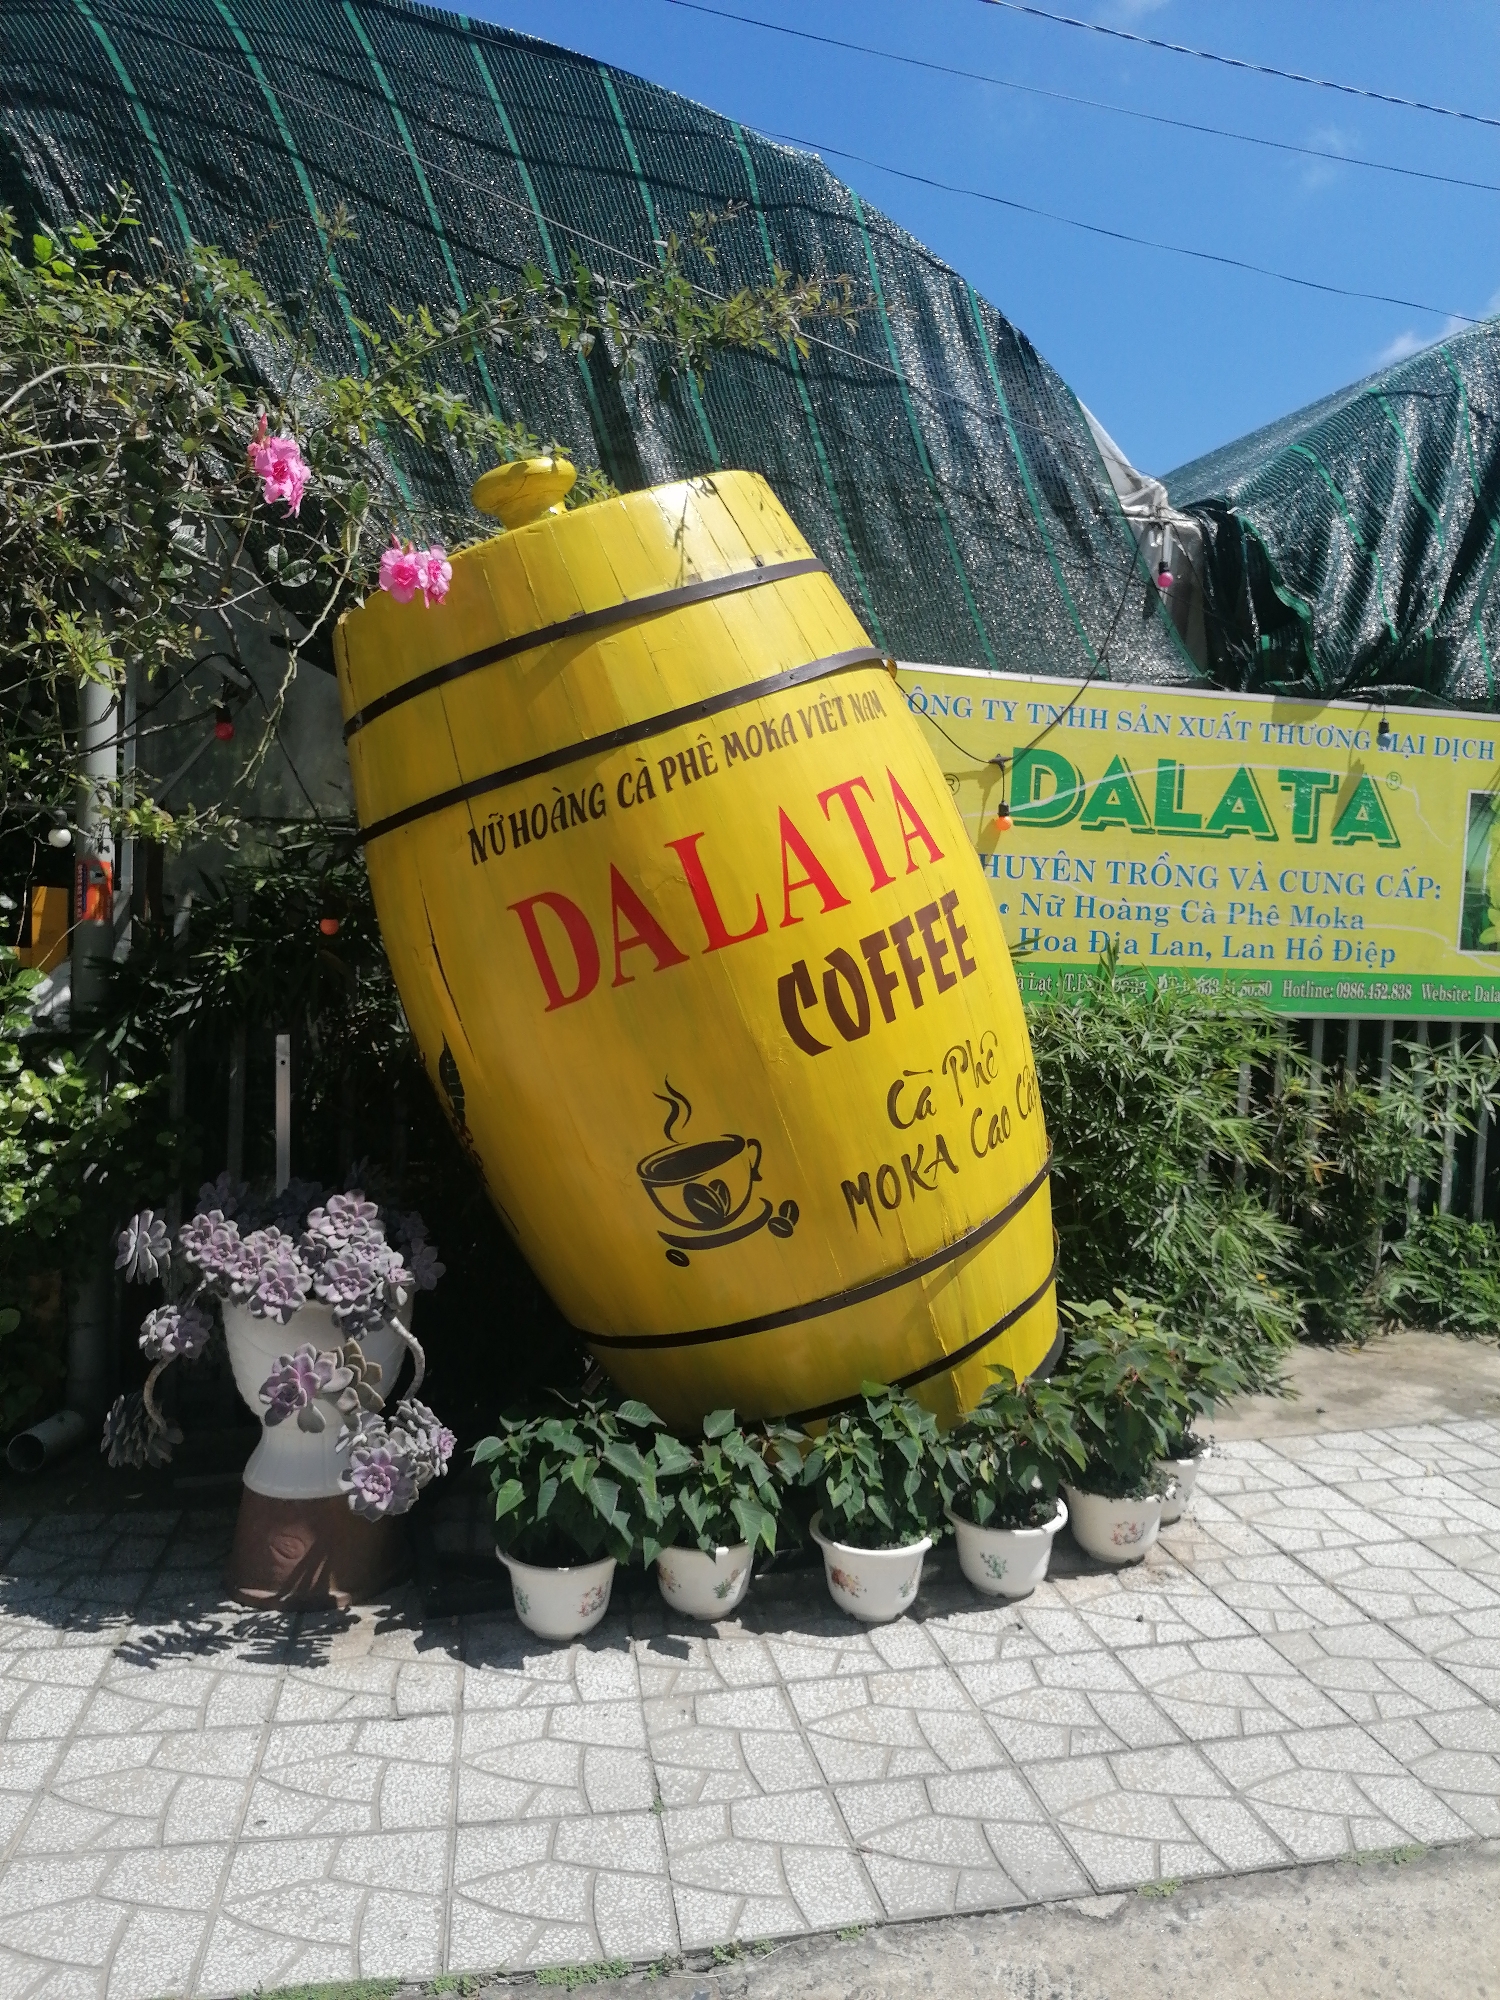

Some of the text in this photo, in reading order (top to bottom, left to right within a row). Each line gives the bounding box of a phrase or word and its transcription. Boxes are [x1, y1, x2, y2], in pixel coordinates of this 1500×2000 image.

[508, 783, 606, 849] HOÀNG
[617, 757, 657, 809] CÀ
[657, 736, 718, 793] PHÊ
[720, 711, 799, 768] MOKA
[847, 690, 887, 724] NAM
[904, 687, 972, 718] ÔNG
[982, 699, 1019, 722] TY
[1027, 703, 1108, 730] TNHH
[1117, 704, 1171, 735] SẢN
[1179, 711, 1252, 742] XUẤT
[1259, 722, 1371, 750] THƯƠNG
[1433, 737, 1495, 763] DỊCH
[1010, 747, 1401, 849] DALATA
[506, 764, 945, 1013] DALATA
[1019, 892, 1365, 930] Nữ Hoàng Cà Phê Moka
[1106, 852, 1219, 890] TRỒNG
[1229, 861, 1269, 892] VÀ
[1279, 869, 1366, 897] CUNG
[1375, 866, 1441, 900] CẤP:
[777, 890, 978, 1057] COFFEE
[1019, 927, 1078, 954] Hoa
[1149, 932, 1212, 961] Lan,
[1222, 935, 1275, 960] Lan
[1286, 935, 1323, 961] Hồ
[1332, 939, 1396, 969] Điệp
[1282, 980, 1334, 998] Hotline:
[1336, 981, 1412, 1000] 0986.452.838
[1422, 983, 1471, 1002] Website:
[887, 1030, 1000, 1130] Cà Phê
[840, 1134, 960, 1238] MOKA
[970, 1106, 1011, 1158] Cao
